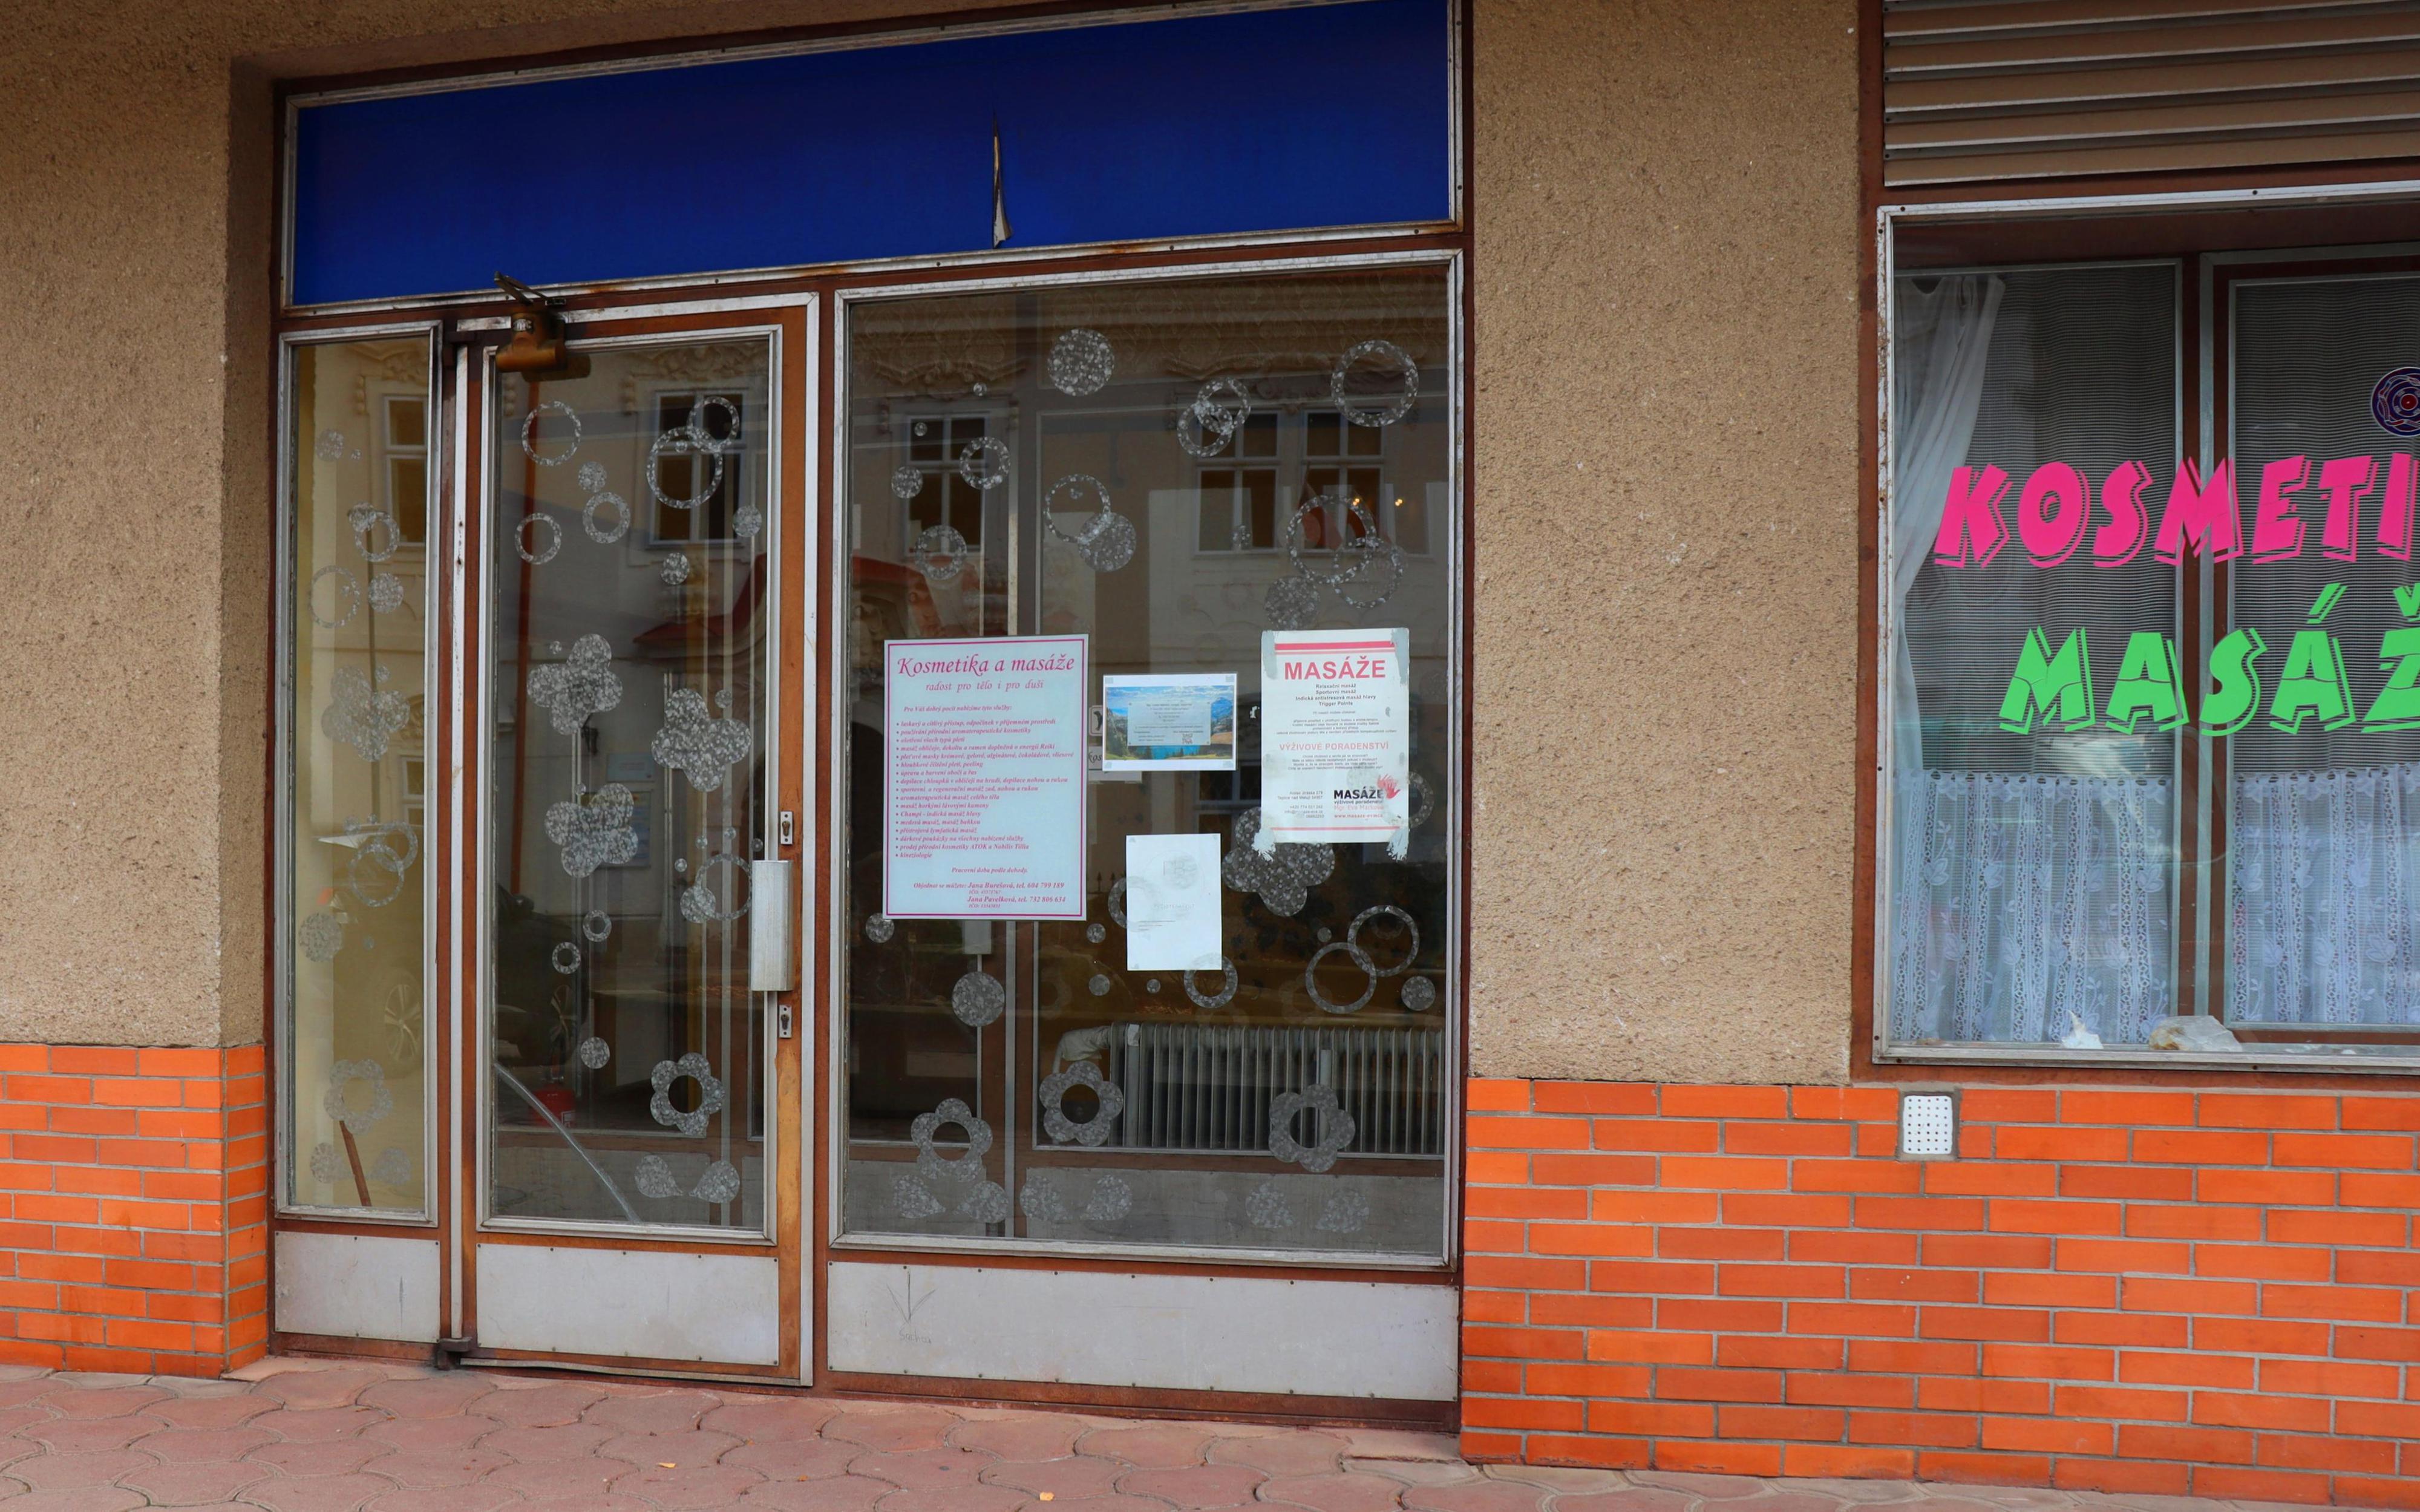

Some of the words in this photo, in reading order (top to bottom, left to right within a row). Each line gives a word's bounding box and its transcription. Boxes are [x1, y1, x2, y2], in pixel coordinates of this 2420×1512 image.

[1935, 452, 2420, 569] KOSMETI
[897, 654, 989, 677] Kosmetika
[995, 661, 1005, 672] a
[1011, 653, 1074, 672] masáže
[1284, 655, 1386, 680] MASÁŽE
[926, 681, 952, 692] radost
[957, 682, 972, 693] pro
[976, 681, 993, 690] tělo
[997, 681, 1001, 690] i
[1005, 681, 1021, 693] pro
[1025, 679, 1044, 689] duši
[1280, 741, 1322, 751] VÝŽIVOVÉ
[1325, 741, 1388, 750] PORADENSTVÍ
[1333, 787, 1384, 799] MASÁŽE
